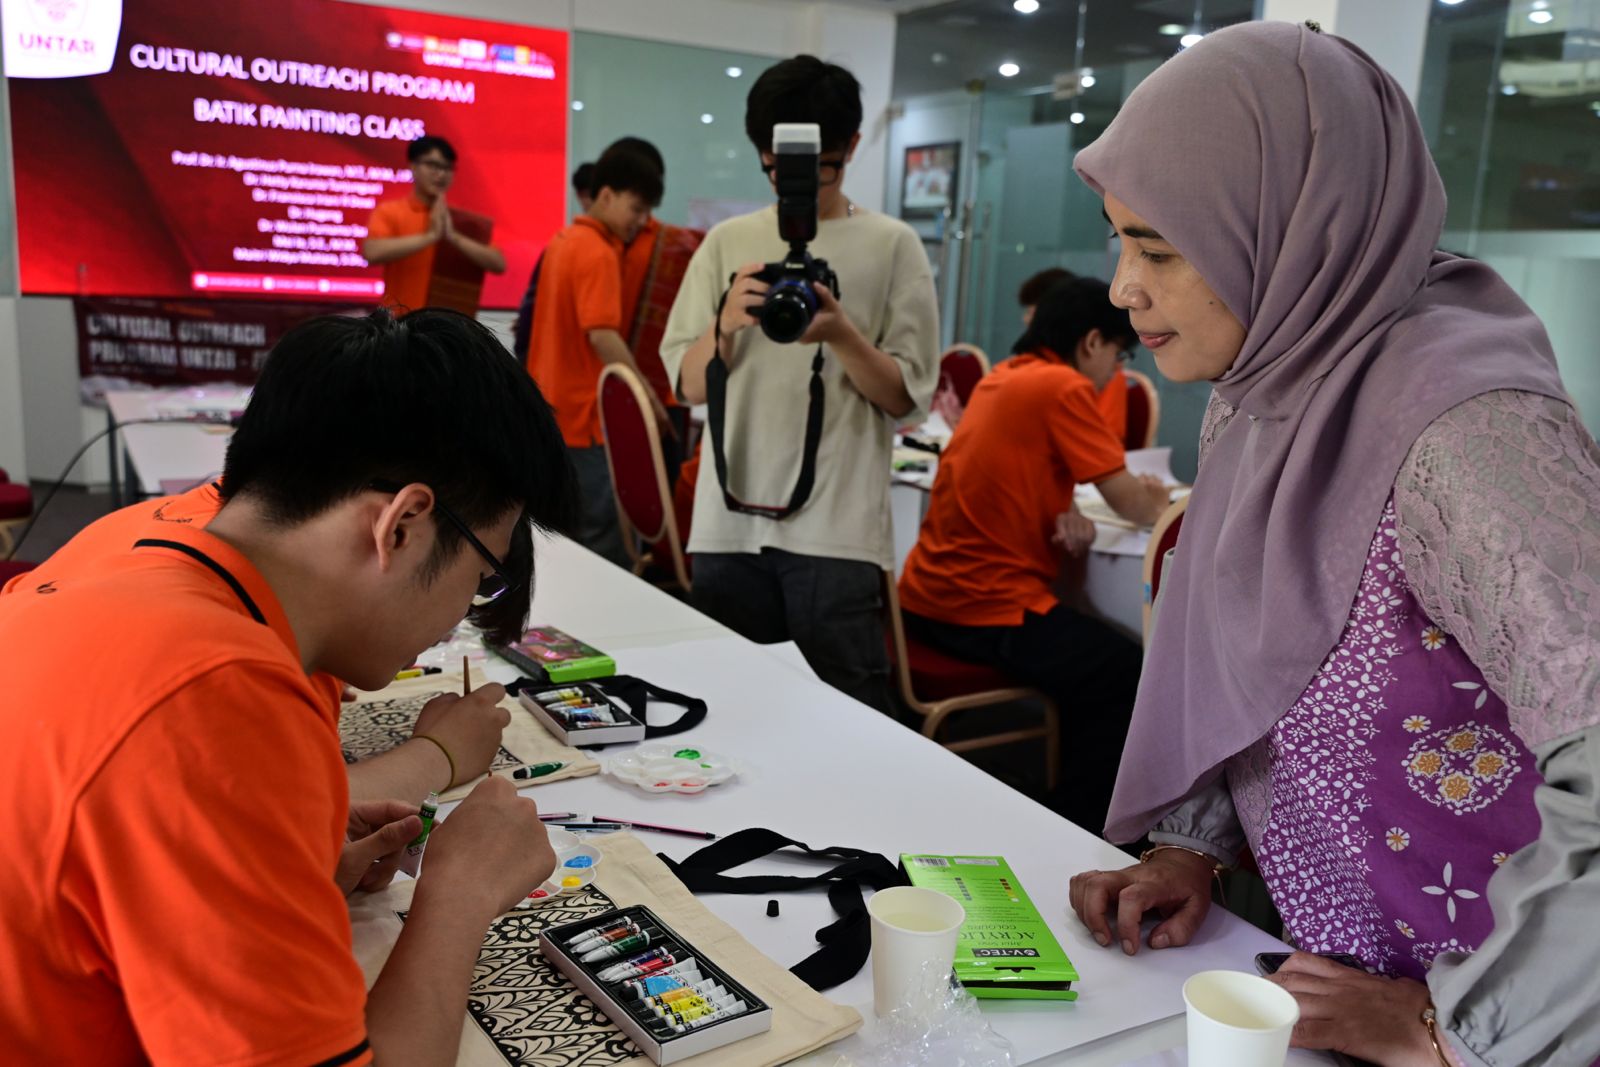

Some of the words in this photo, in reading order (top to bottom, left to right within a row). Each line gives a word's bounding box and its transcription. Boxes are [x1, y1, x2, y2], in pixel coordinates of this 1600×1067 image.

[19, 32, 96, 54] UNTAR
[130, 43, 249, 79] CULTURAL
[251, 57, 369, 93] OUTREACH
[372, 70, 475, 104] PROGRAM
[193, 97, 258, 126] BATIK
[260, 104, 361, 136] PAINTING
[363, 114, 426, 141] CLASS
[960, 931, 1036, 939] ACRYLIC
